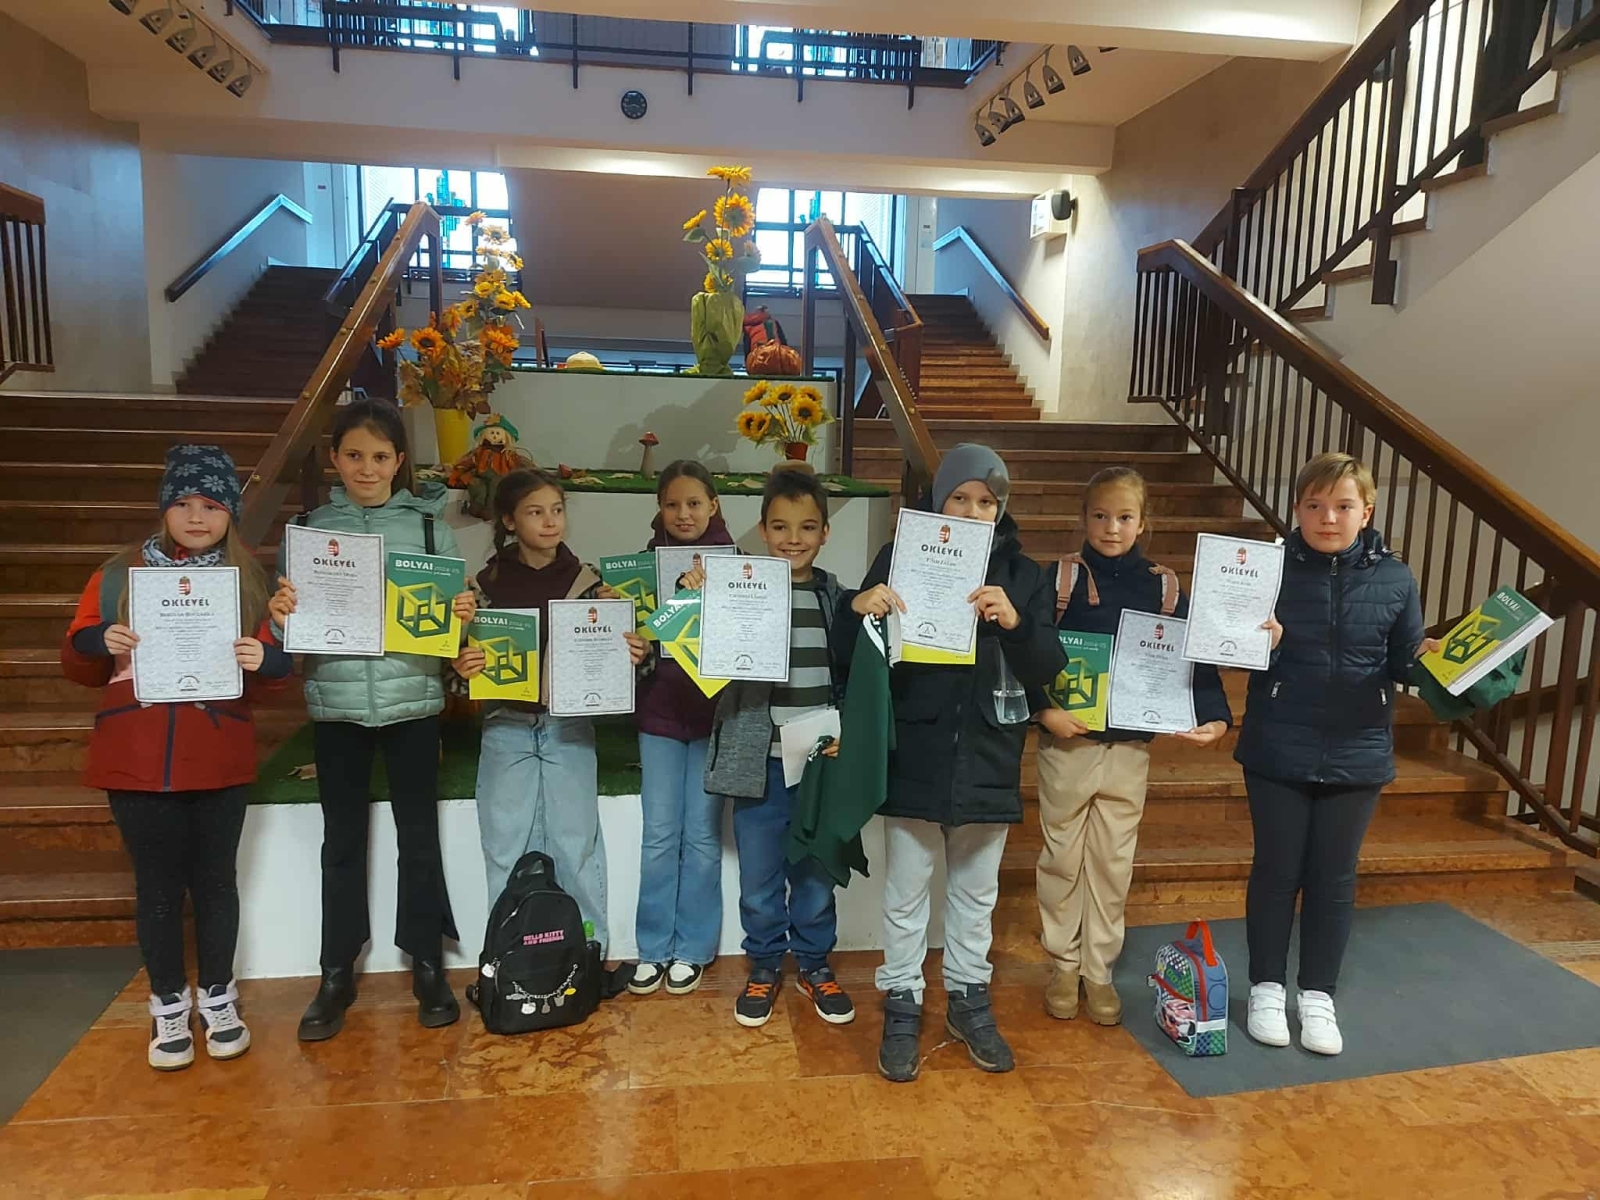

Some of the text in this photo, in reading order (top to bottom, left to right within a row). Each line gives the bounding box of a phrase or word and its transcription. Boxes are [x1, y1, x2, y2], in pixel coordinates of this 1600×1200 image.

[313, 557, 357, 568] OKLEVÉL
[395, 559, 434, 571] BOLYAI
[605, 560, 637, 570] BOLYAI
[1220, 565, 1259, 578] OKLEVÉL
[728, 580, 767, 590] OKLEVÉL
[161, 596, 210, 607] OKLEVÉL
[1497, 592, 1520, 611] BOLYAI
[474, 616, 508, 626] BOLYAI
[653, 603, 684, 628] BOLYA
[574, 624, 613, 634] OKLEVÉL
[1058, 635, 1084, 646] LYAI
[1139, 639, 1175, 652] OKLEVÉL
[544, 930, 564, 938] KITTY
